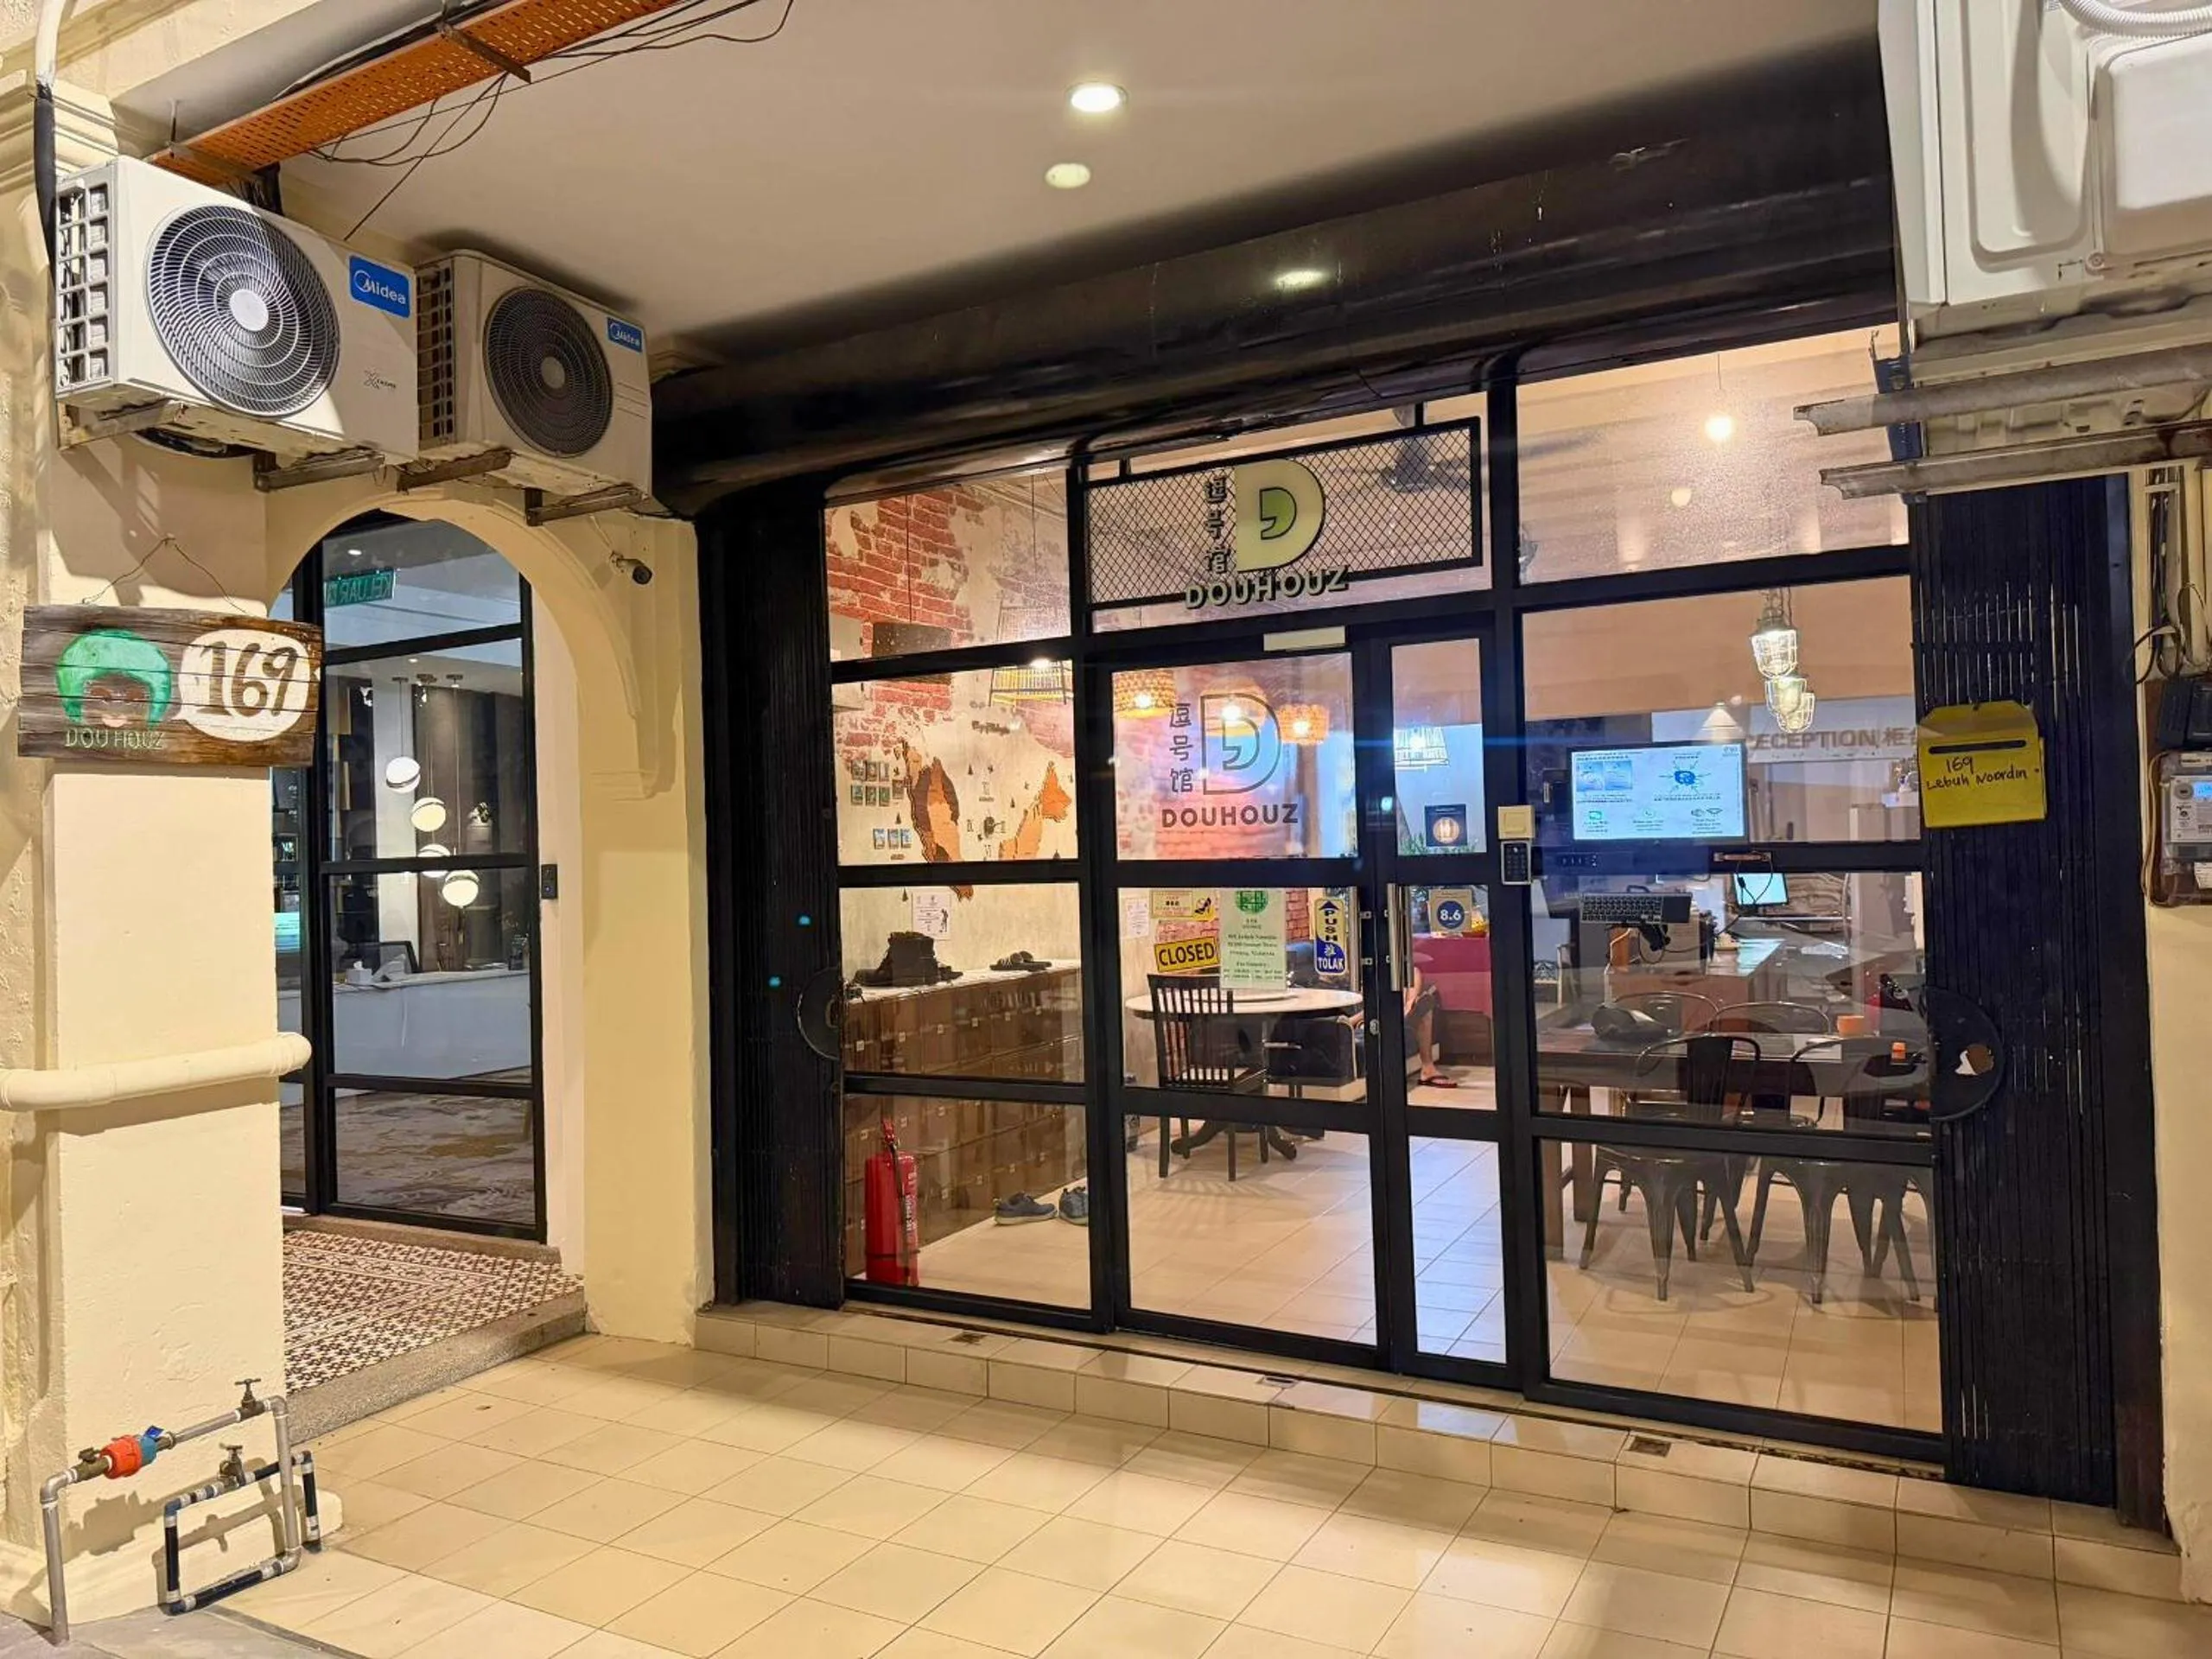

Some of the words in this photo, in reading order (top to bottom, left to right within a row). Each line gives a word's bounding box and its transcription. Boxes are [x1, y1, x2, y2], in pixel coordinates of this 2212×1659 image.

[353, 269, 406, 304] Midea
[1185, 565, 1350, 610] DOUHOUZ
[200, 640, 298, 718] 169
[1926, 773, 1969, 790] Lebuh
[1976, 764, 2027, 786] Noordin
[1946, 756, 1974, 774] 169
[1161, 803, 1299, 828] DOUHOUZ
[1324, 909, 1338, 942] PUSH
[1440, 909, 1461, 921] 8.6
[1159, 942, 1215, 966] CLOSED
[1318, 957, 1344, 969] TOLAK
